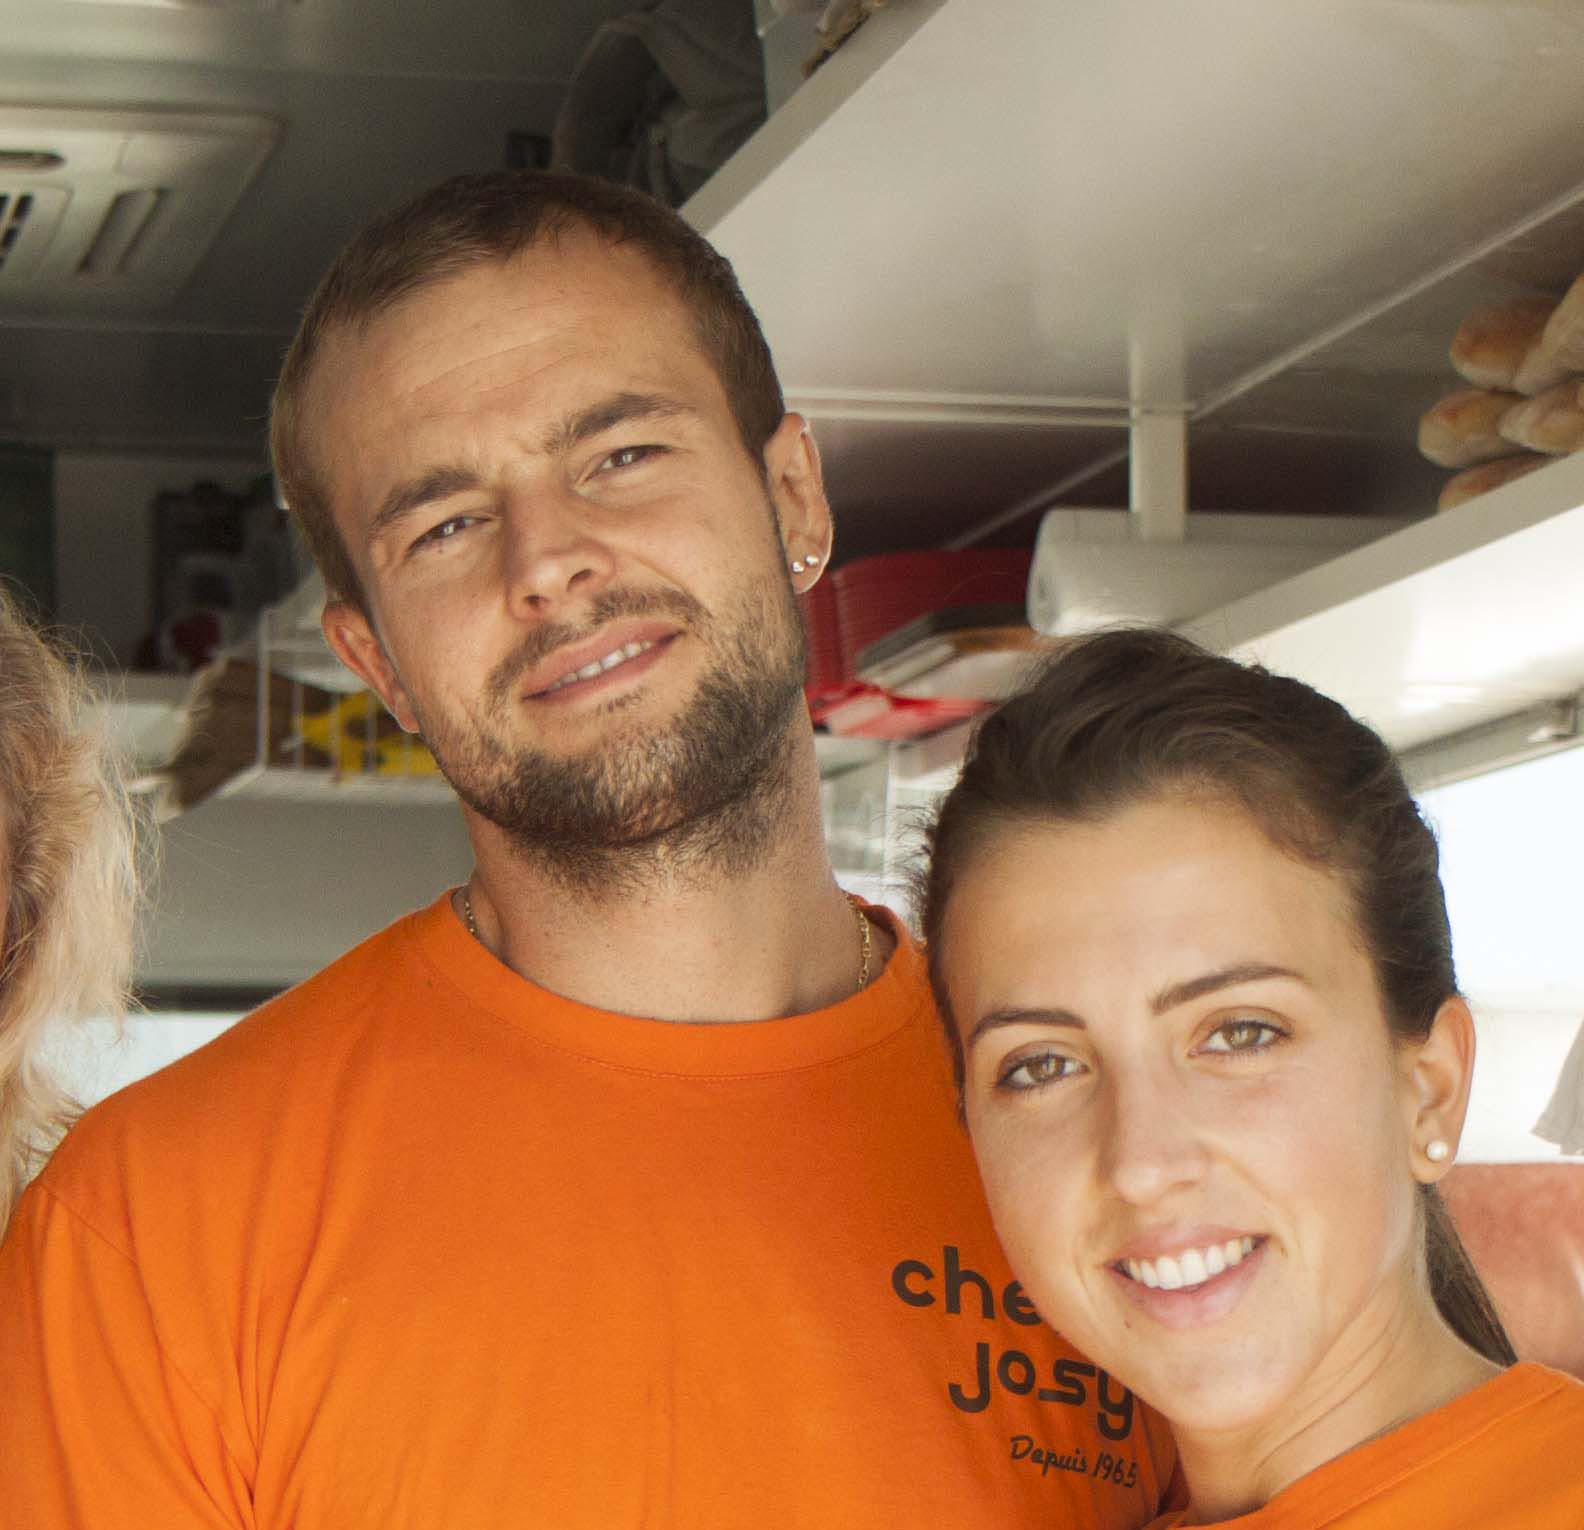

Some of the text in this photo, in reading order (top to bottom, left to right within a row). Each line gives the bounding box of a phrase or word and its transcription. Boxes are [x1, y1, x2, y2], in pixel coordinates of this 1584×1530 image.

[891, 1245, 1043, 1327] che
[1009, 1434, 1140, 1489] Depuis 1965
